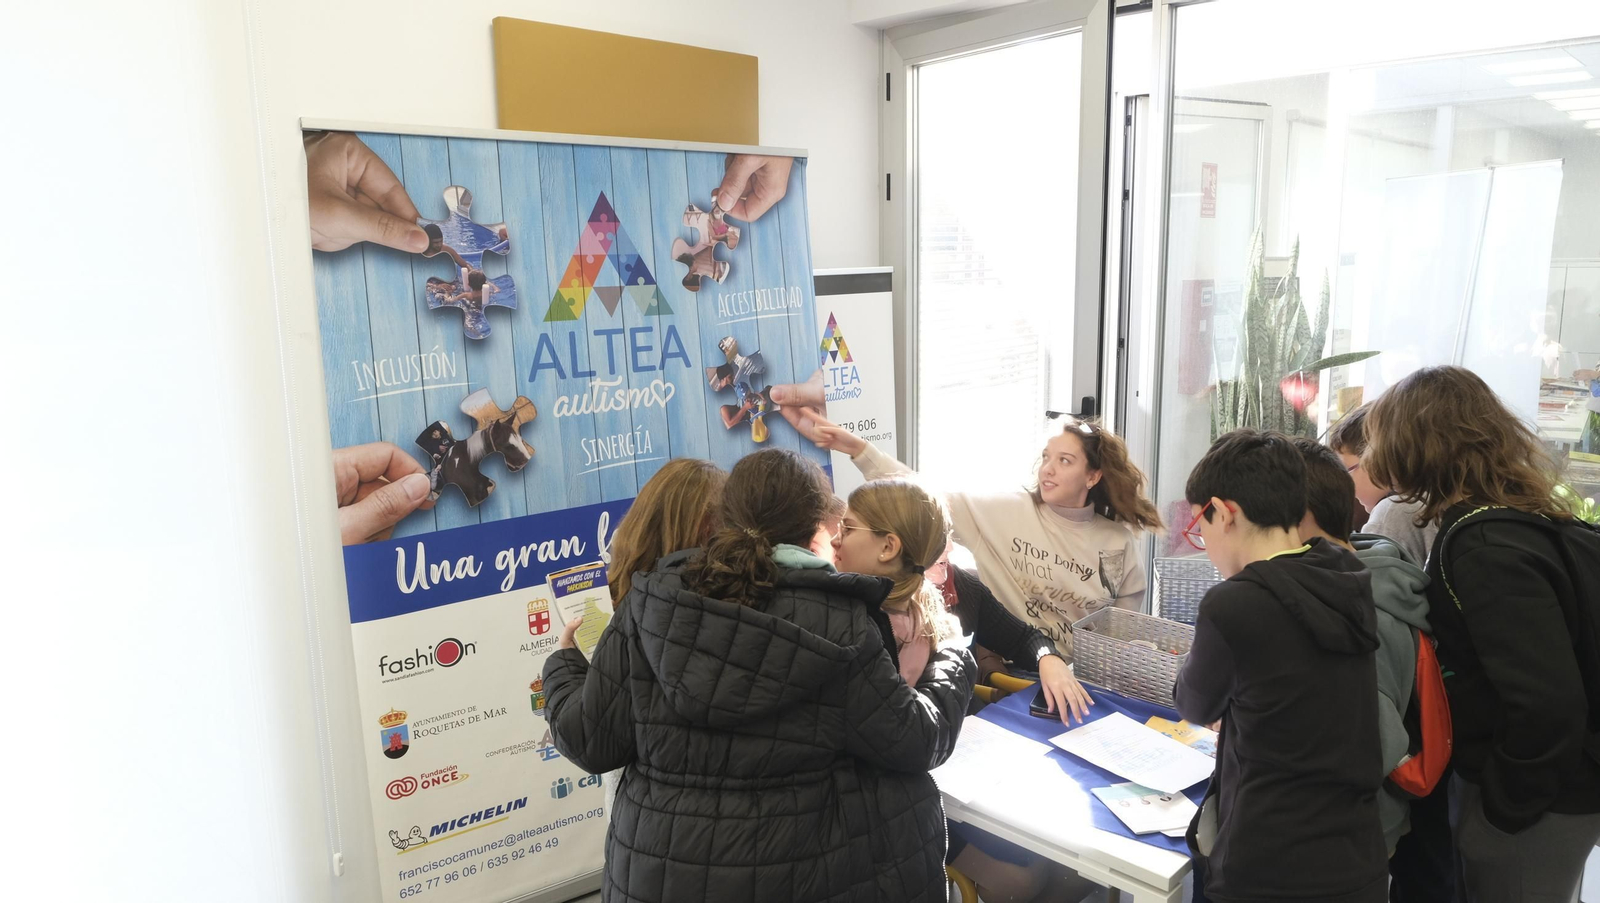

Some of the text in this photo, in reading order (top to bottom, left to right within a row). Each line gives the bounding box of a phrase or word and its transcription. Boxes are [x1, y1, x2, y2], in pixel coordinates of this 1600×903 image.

[717, 286, 803, 318] ACCESIBILIDAD
[528, 324, 692, 383] ALTEA
[351, 345, 456, 392] INCLUSIÓN
[838, 418, 877, 434] 79 606
[581, 424, 653, 467] SINERGÍA
[1011, 537, 1049, 561] STOP
[395, 541, 483, 594] Una
[495, 535, 586, 592] gran
[1010, 556, 1053, 581] what
[519, 636, 561, 653] ALMERÍA
[531, 646, 553, 657] CIUDAD
[412, 705, 478, 729] AYUNTAMIENTO DE
[413, 718, 465, 740] ROQUETAS
[485, 739, 536, 758] CONFEDERACIÓN
[510, 744, 537, 756] AUTISMO
[420, 764, 458, 780] Fundación
[421, 771, 460, 790] ONCE
[429, 796, 528, 838] MICHELIN
[398, 806, 604, 881] franciscocamunez@alteaautismo.org
[399, 883, 423, 899] 652
[426, 876, 441, 890] 77
[444, 870, 460, 883] 96
[462, 864, 478, 878] 06
[487, 854, 509, 870] 635
[511, 848, 526, 861] 92
[528, 842, 543, 855] 46
[545, 837, 560, 850] 49
